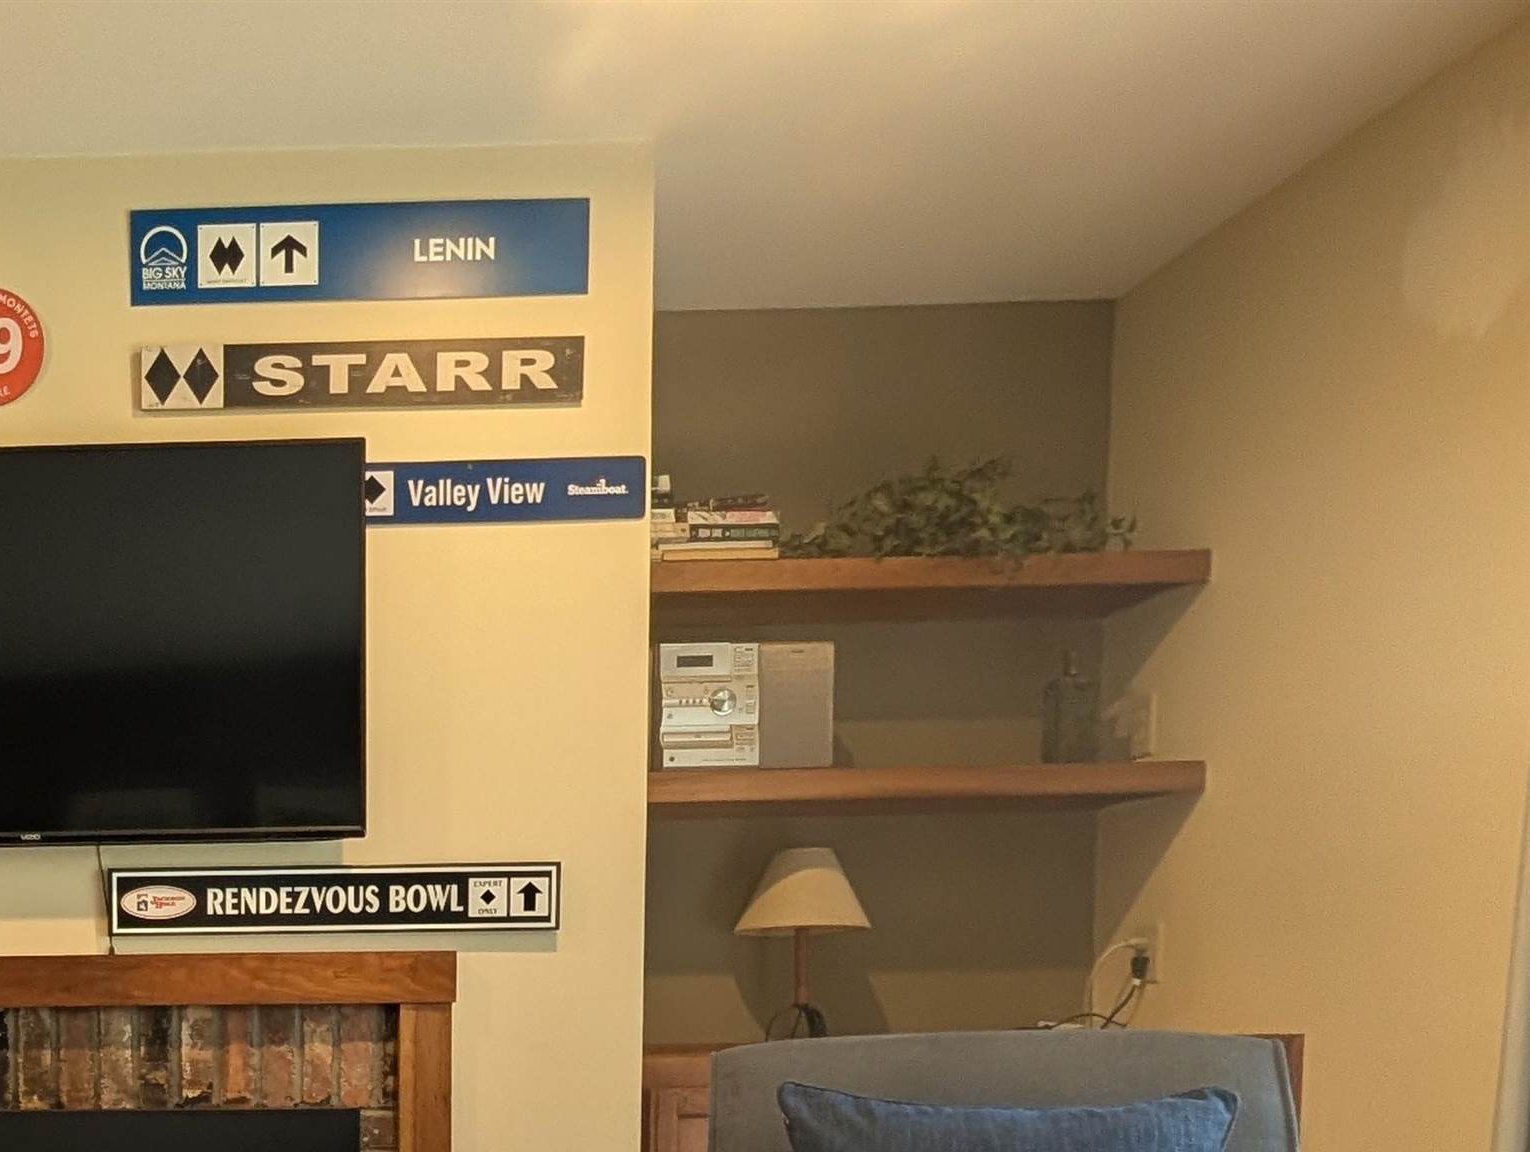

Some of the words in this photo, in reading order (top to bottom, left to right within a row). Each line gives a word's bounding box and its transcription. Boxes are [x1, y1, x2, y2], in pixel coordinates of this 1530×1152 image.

[414, 236, 496, 263] LENIN
[142, 267, 163, 280] BIG
[164, 265, 188, 279] SKY
[142, 280, 187, 291] MONTANA
[252, 348, 559, 397] STARR
[407, 478, 481, 512] Valley
[486, 477, 546, 504] View
[206, 885, 381, 916] RENDEZVOUS
[389, 883, 464, 913] BOWL
